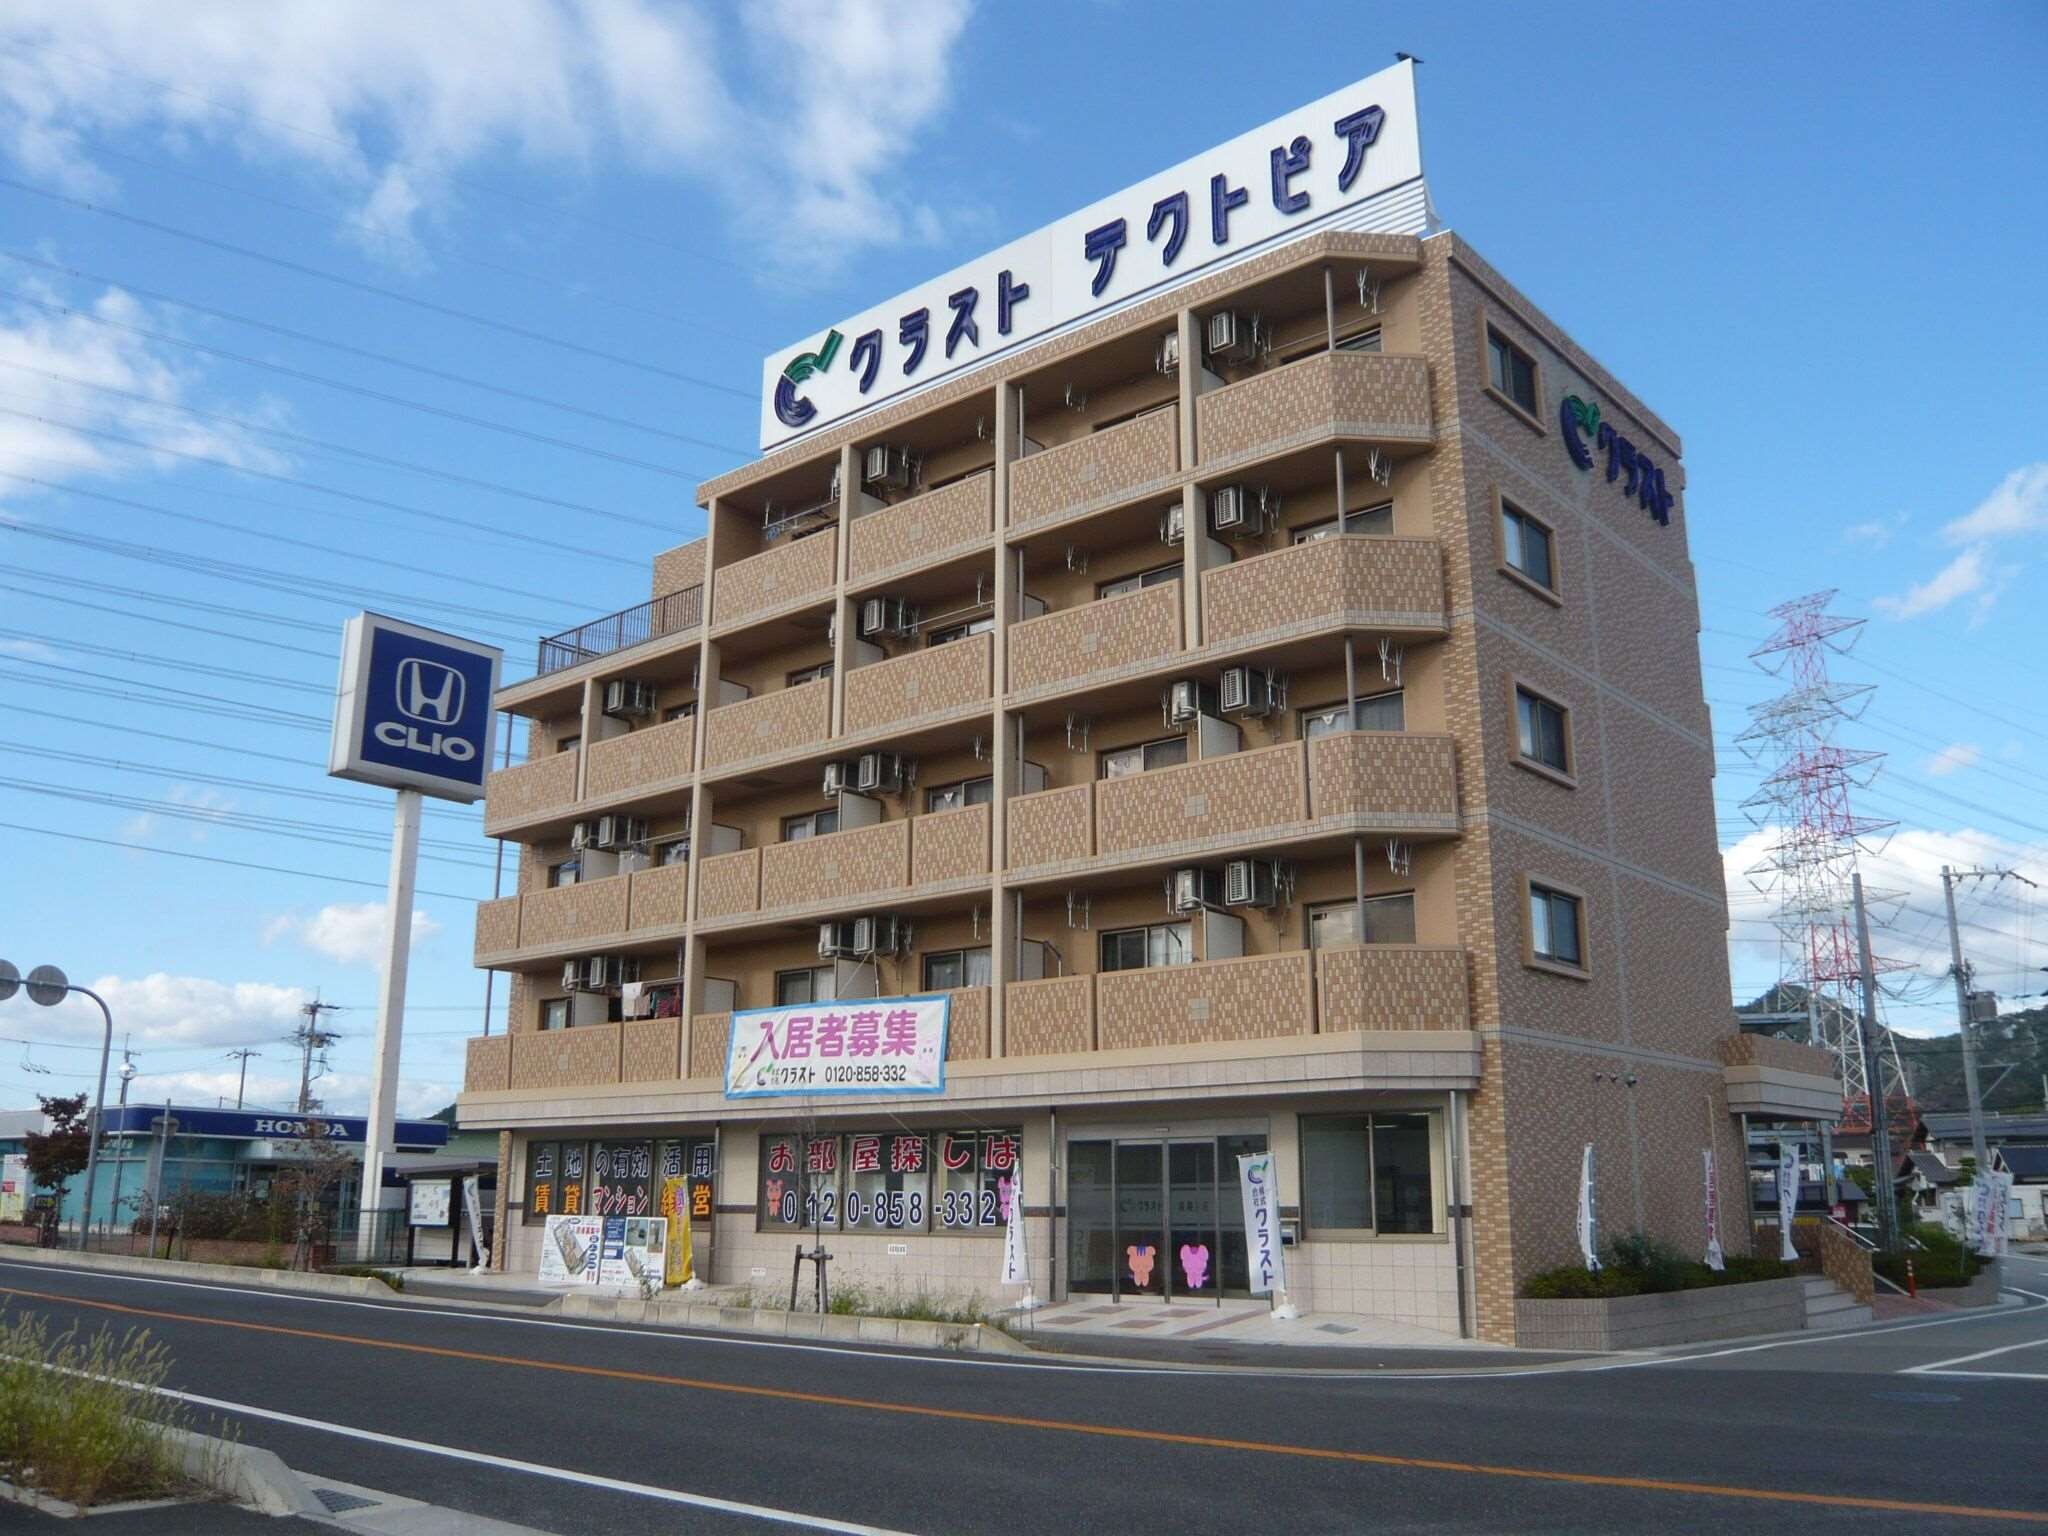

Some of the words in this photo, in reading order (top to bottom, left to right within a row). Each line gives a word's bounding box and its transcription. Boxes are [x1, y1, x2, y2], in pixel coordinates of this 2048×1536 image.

[849, 269, 1030, 394] クラスト
[1084, 103, 1386, 298] テクトピア
[373, 721, 476, 762] CLIO
[750, 1008, 919, 1063] 入居者募集
[768, 1135, 1017, 1174] お部屋探しは
[1255, 1207, 1274, 1287] クラスト
